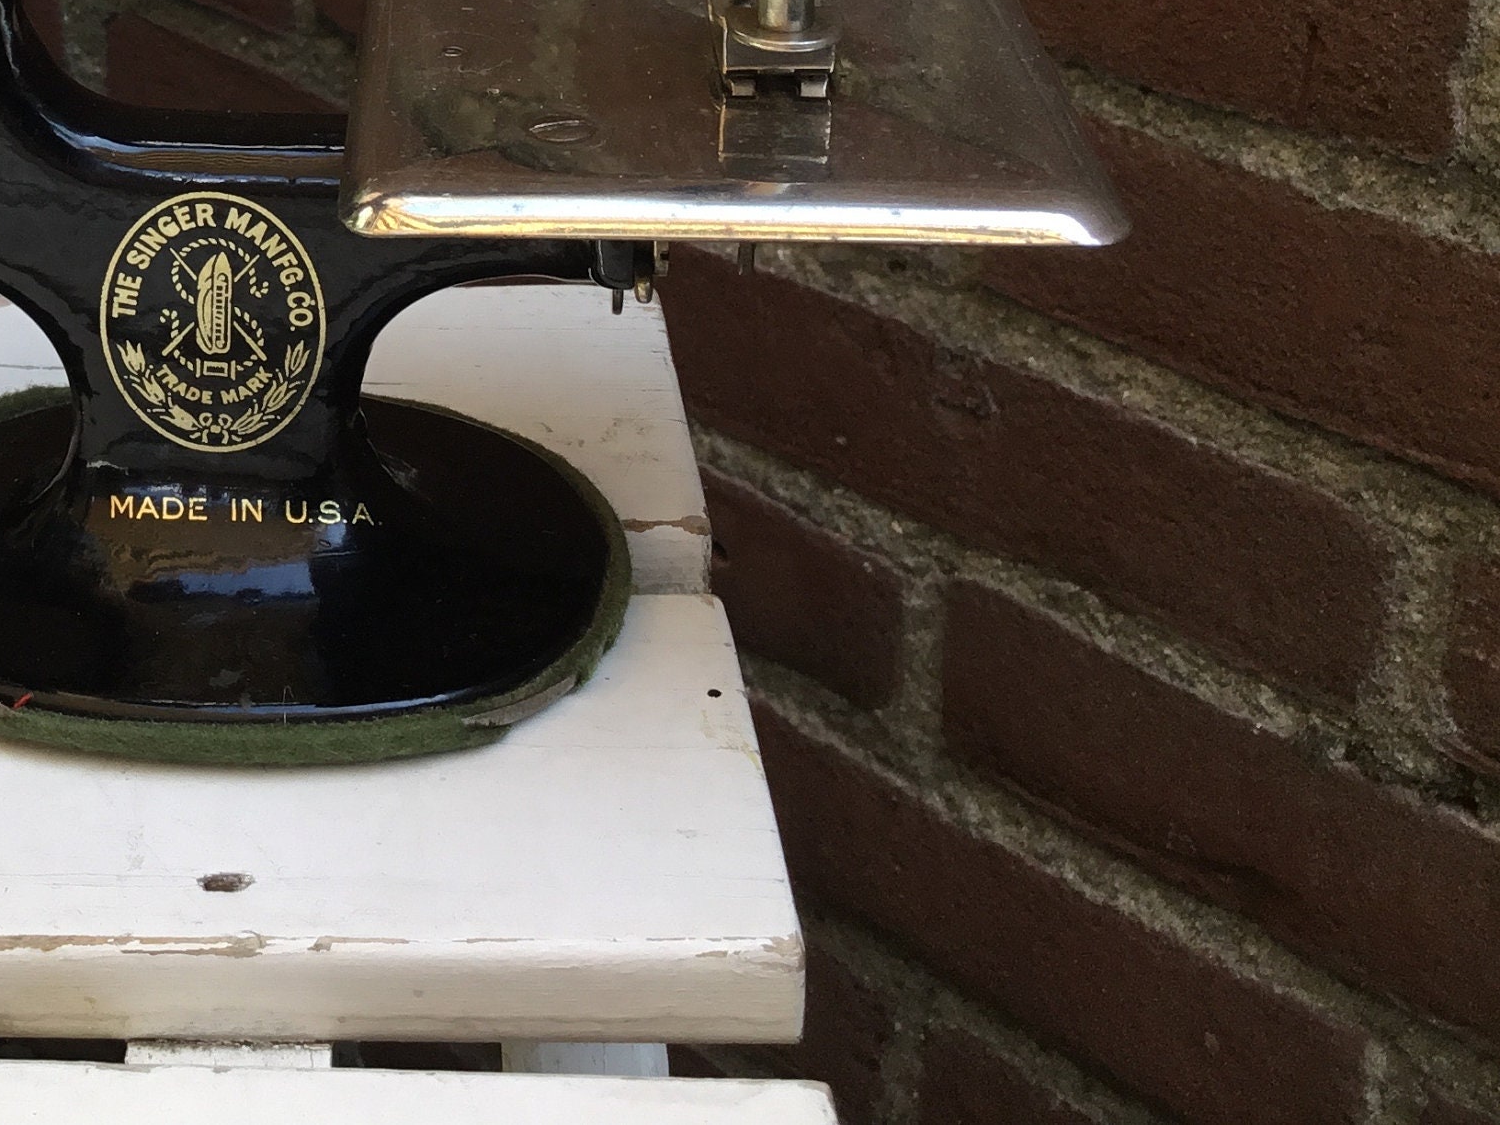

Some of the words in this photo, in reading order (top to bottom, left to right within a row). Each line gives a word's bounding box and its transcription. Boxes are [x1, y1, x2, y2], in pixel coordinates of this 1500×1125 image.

[126, 202, 217, 270] SINGER
[111, 273, 143, 319] THE
[155, 363, 213, 405] TRADE
[220, 365, 273, 405] MARK
[109, 494, 209, 522] MADE
[230, 497, 263, 523] IN
